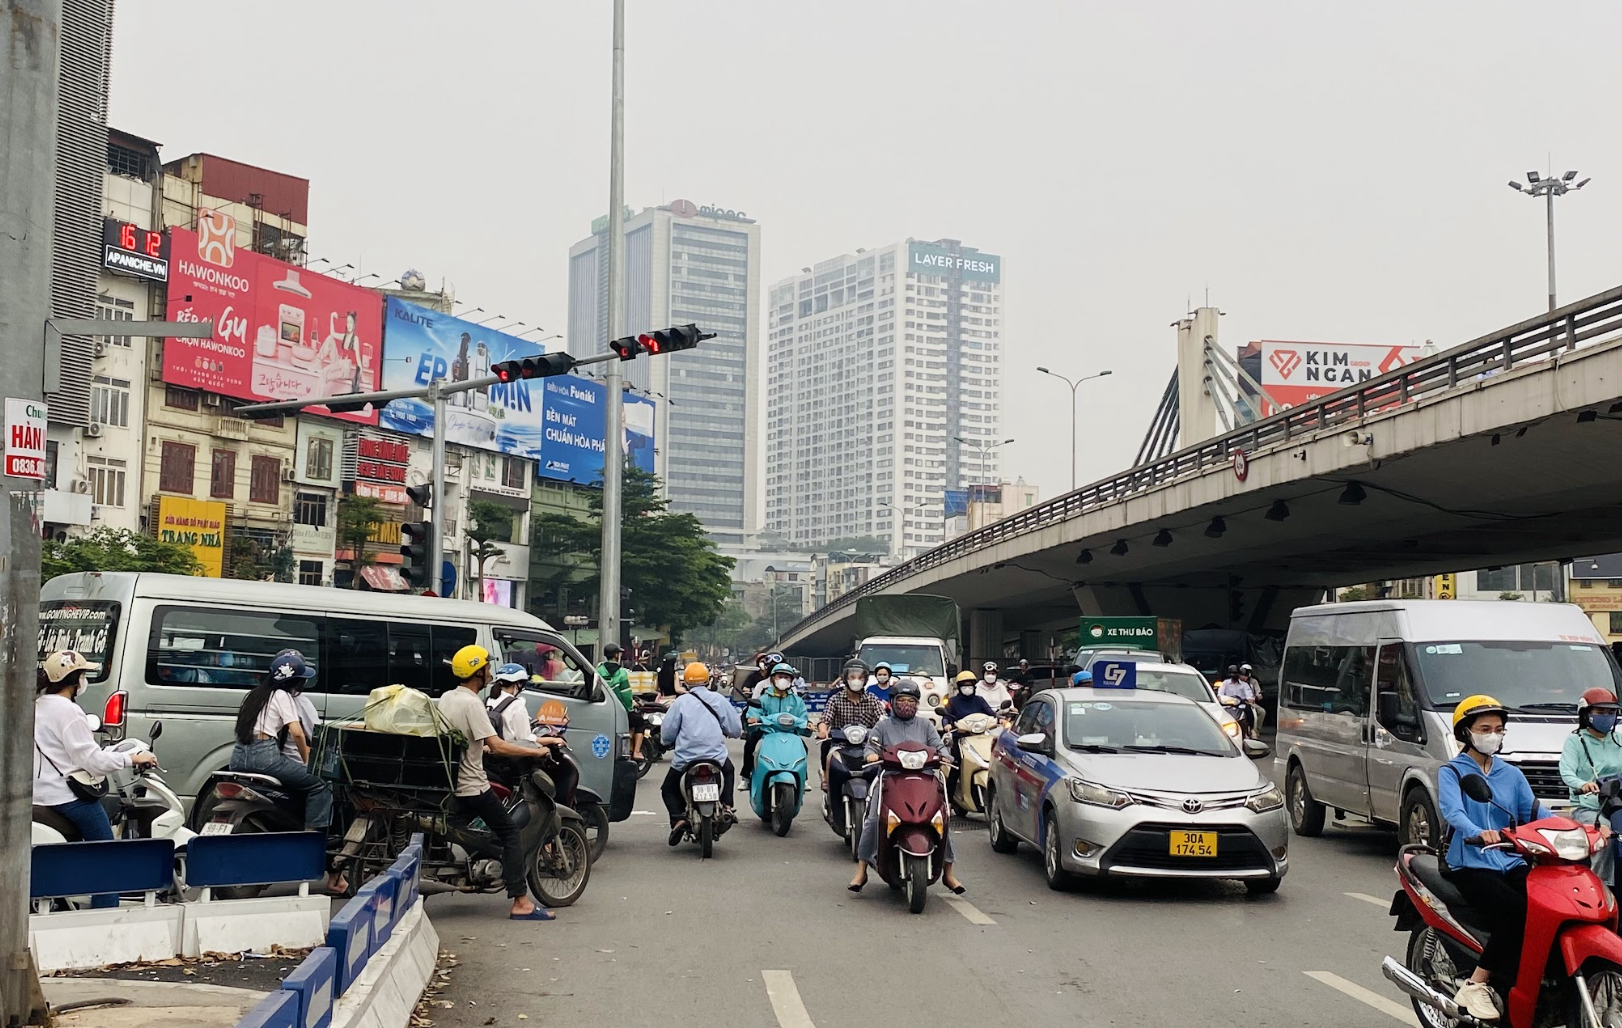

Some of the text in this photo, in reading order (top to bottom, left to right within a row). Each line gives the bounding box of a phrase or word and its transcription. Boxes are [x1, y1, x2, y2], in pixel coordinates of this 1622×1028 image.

[108, 251, 165, 275] APANICHE.VN
[915, 253, 994, 273] LAYER FRESH
[179, 260, 249, 292] HAWONKOO
[394, 308, 434, 329] KALITE
[200, 339, 245, 358] HAWONKOO
[1306, 351, 1348, 366] KIM
[1306, 367, 1371, 383] NGAN
[570, 384, 596, 404] Funiki
[546, 406, 577, 428] BỀN MÁT
[574, 433, 591, 450] HÒA
[161, 530, 198, 546] TRANG
[1107, 628, 1117, 636] XE
[1136, 626, 1154, 636] BÁO
[1104, 663, 1127, 686] G7
[1184, 833, 1204, 844] 30A
[1176, 844, 1212, 856] 174.54
